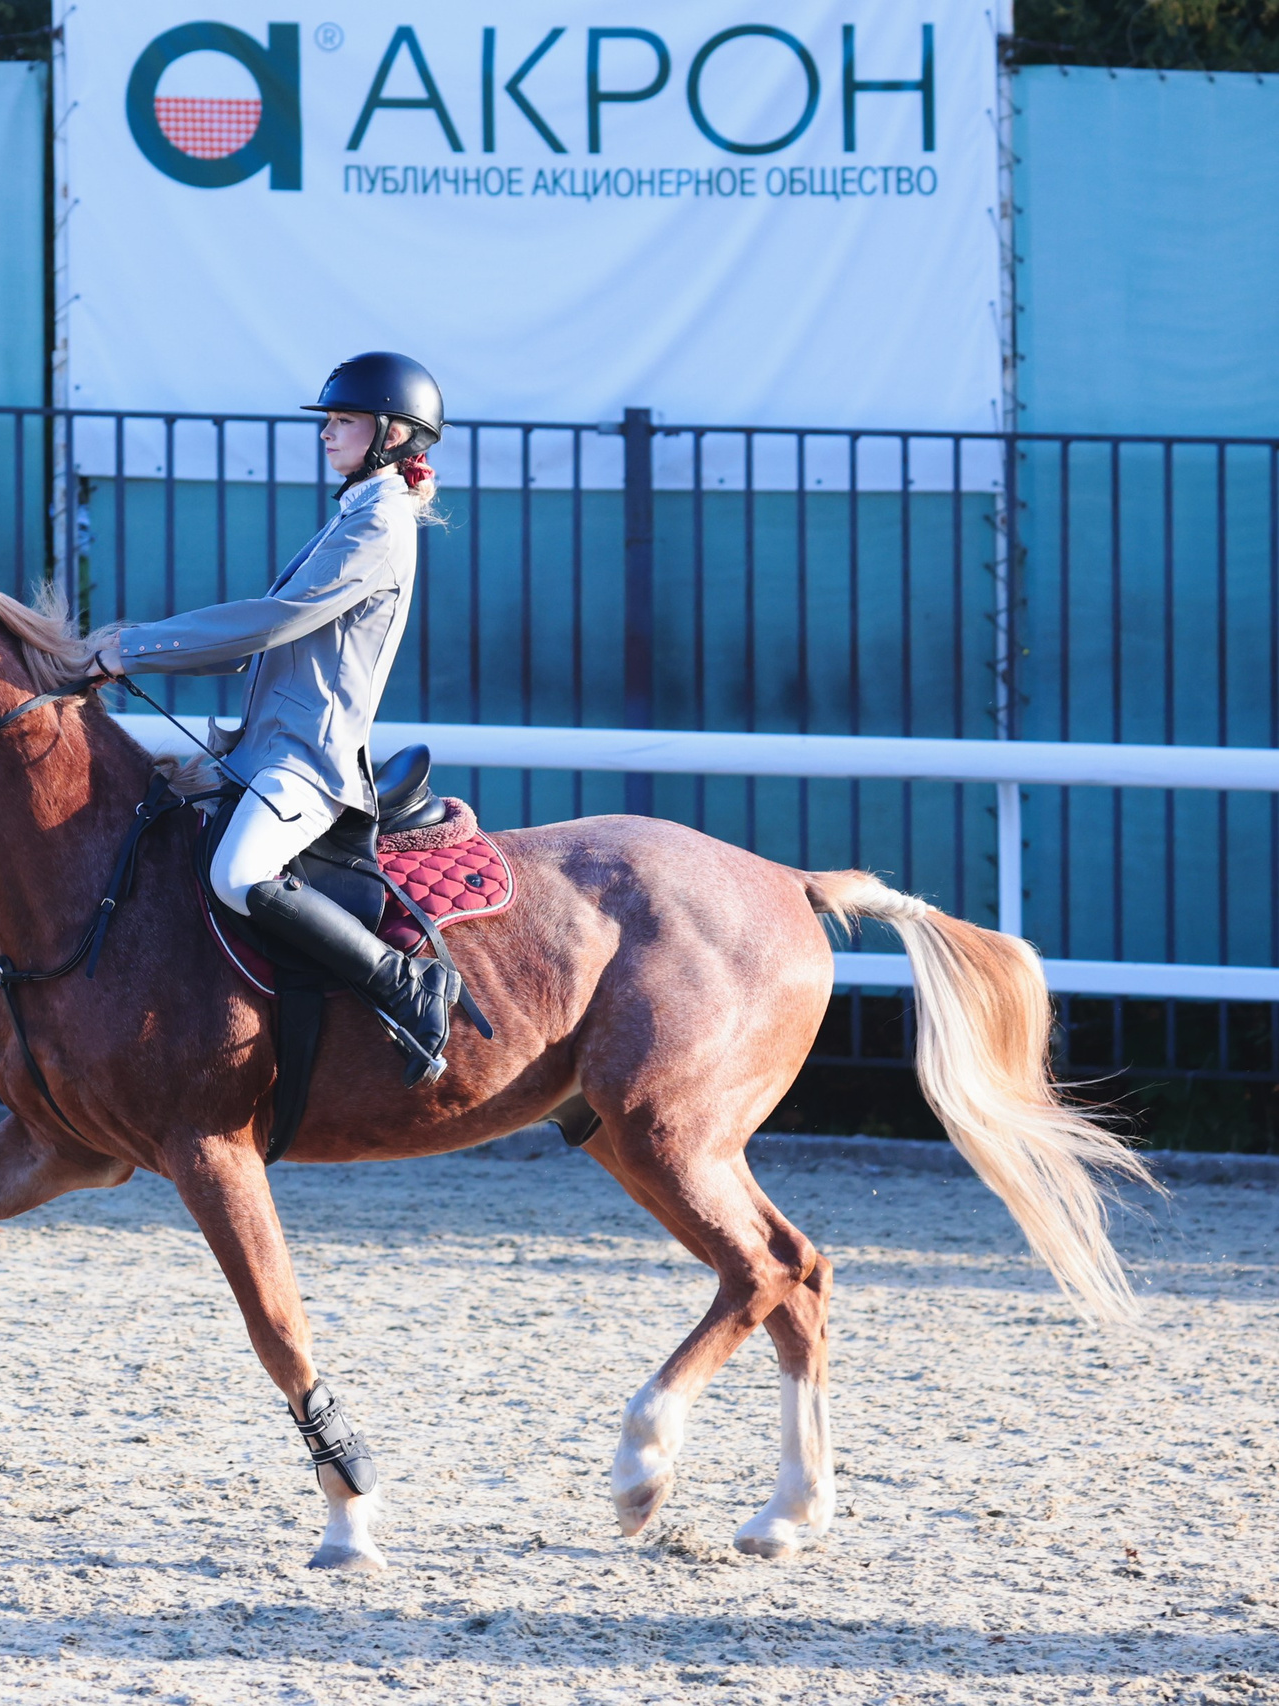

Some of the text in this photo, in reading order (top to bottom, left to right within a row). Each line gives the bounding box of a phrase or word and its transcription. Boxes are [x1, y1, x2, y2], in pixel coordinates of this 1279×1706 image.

[345, 23, 935, 155] АКРОН
[343, 165, 937, 202] ПУБЛИЧНОЕ АКЦИОНЕРНОЕ ОБЩЕСТВО
